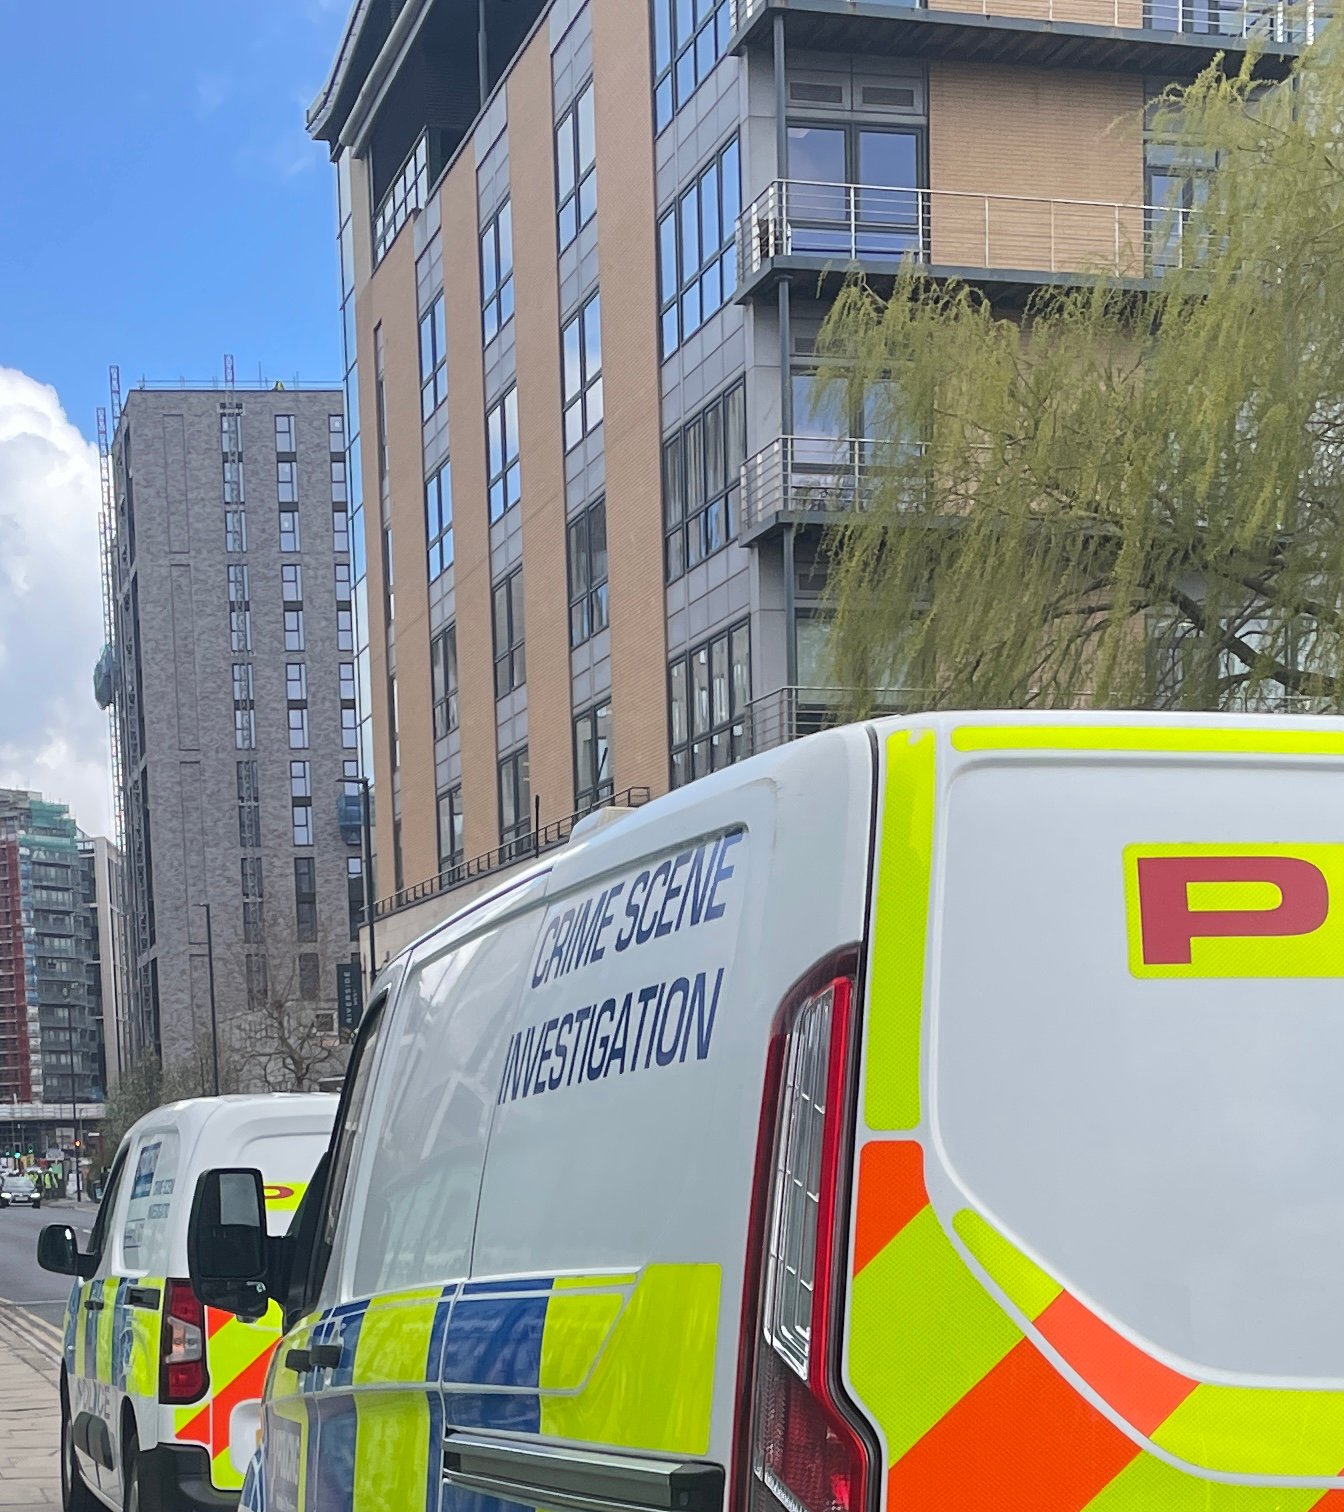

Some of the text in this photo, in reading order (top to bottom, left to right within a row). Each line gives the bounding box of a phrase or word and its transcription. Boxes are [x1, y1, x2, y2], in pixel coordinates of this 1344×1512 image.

[531, 833, 743, 989] CRIME SCENE
[497, 968, 724, 1105] INVESTIGATION
